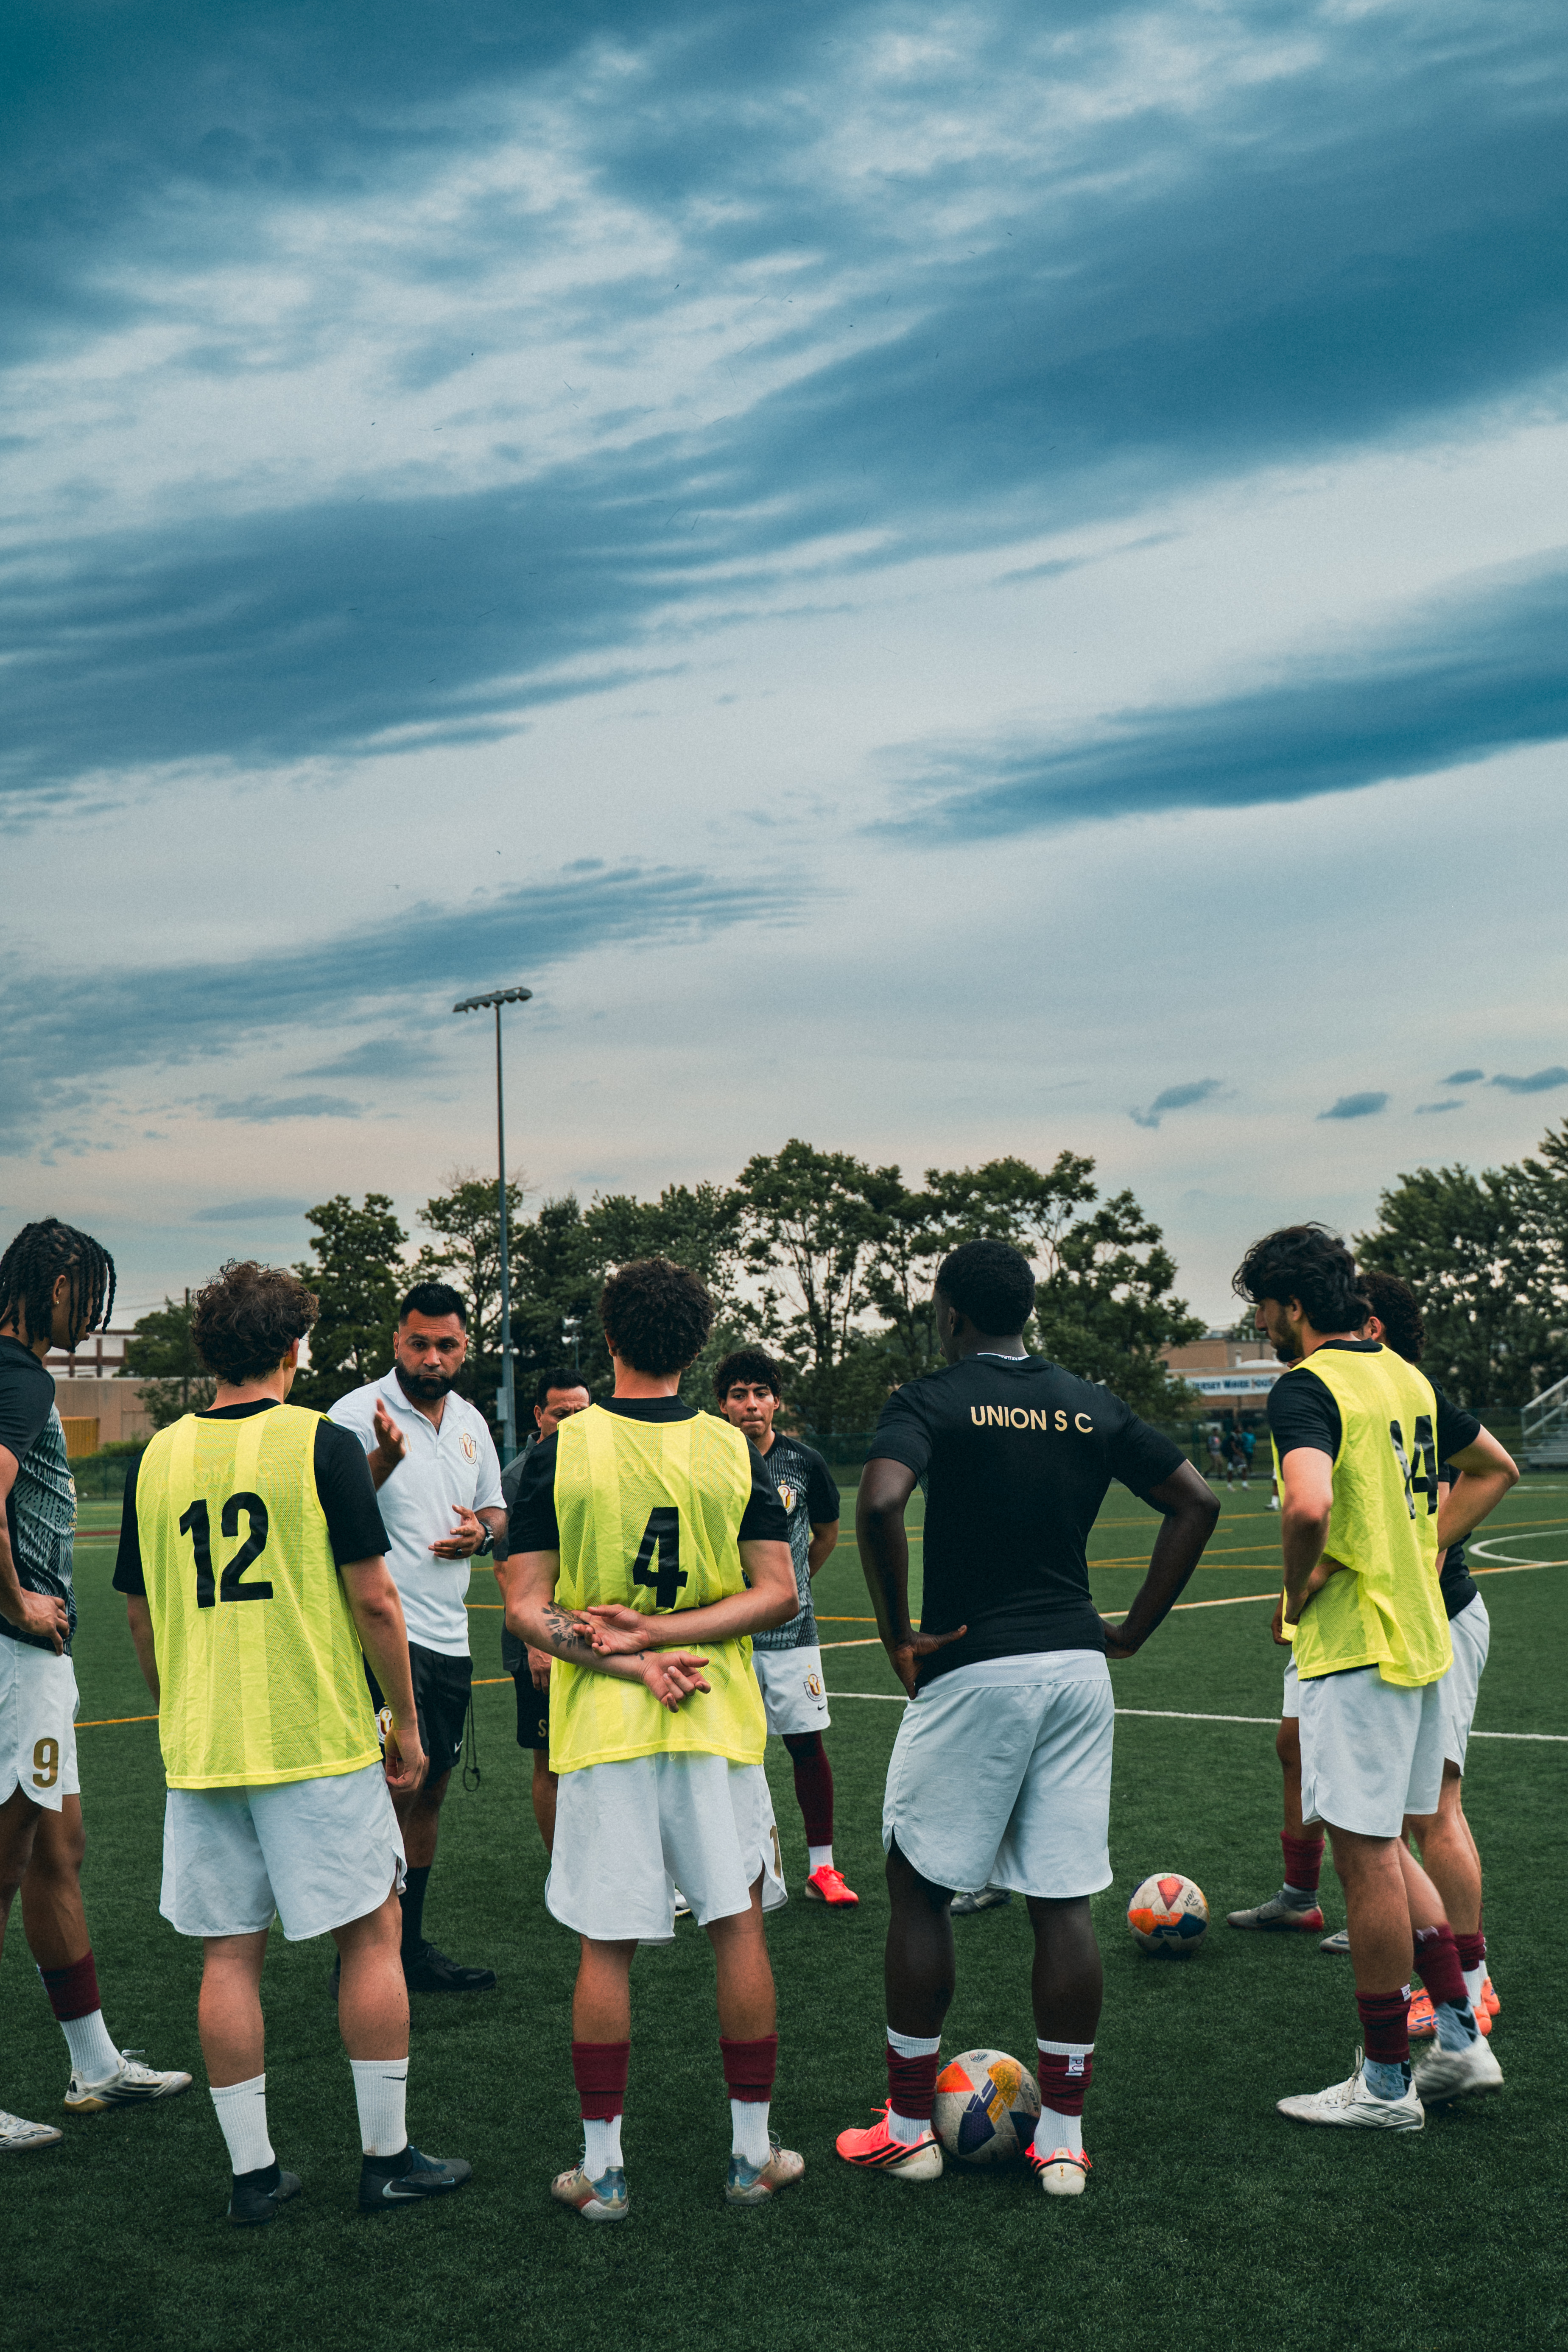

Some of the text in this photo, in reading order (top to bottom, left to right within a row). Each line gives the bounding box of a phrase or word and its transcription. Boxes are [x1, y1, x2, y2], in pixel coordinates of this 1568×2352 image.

[970, 1405, 1047, 1430] UNION
[1390, 1415, 1438, 1520] 14
[179, 1492, 274, 1609] 12
[632, 1506, 688, 1610] 4
[33, 1737, 59, 1788] 9
